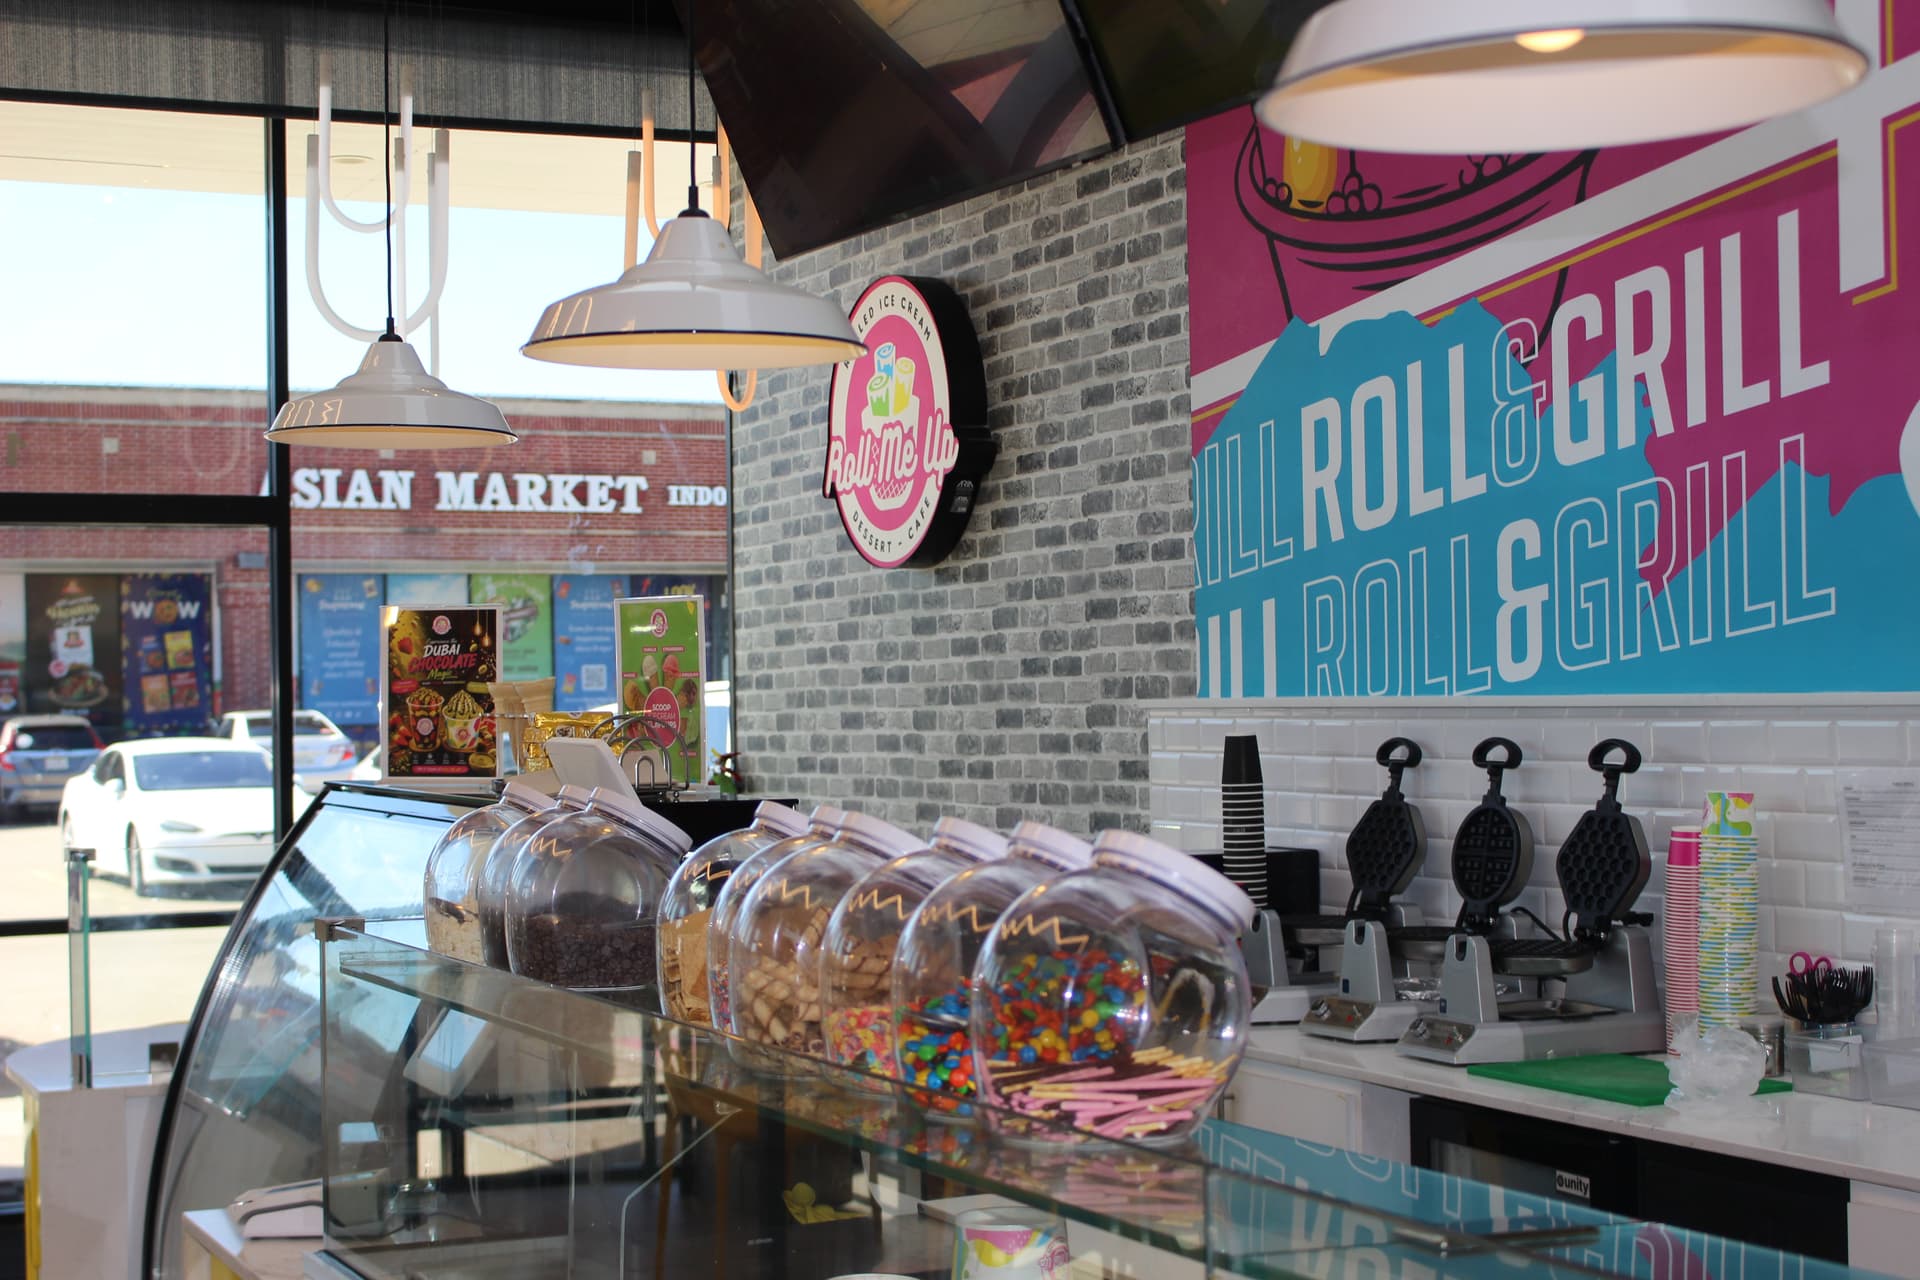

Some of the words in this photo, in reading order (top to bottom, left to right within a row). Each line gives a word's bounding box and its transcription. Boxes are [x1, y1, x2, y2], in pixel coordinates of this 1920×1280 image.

[879, 293, 895, 311] ICE
[900, 296, 931, 341] CREAM
[826, 434, 874, 490] Roll
[878, 427, 918, 482] Me
[923, 413, 959, 486] Up
[259, 468, 415, 509] SIAN
[435, 471, 649, 514] MARKET
[852, 510, 892, 553] DESSERT
[907, 496, 931, 539] CAFE
[407, 653, 477, 673] CHOCOLATE
[423, 643, 461, 658] DUBAI
[652, 703, 671, 711] SCOOP
